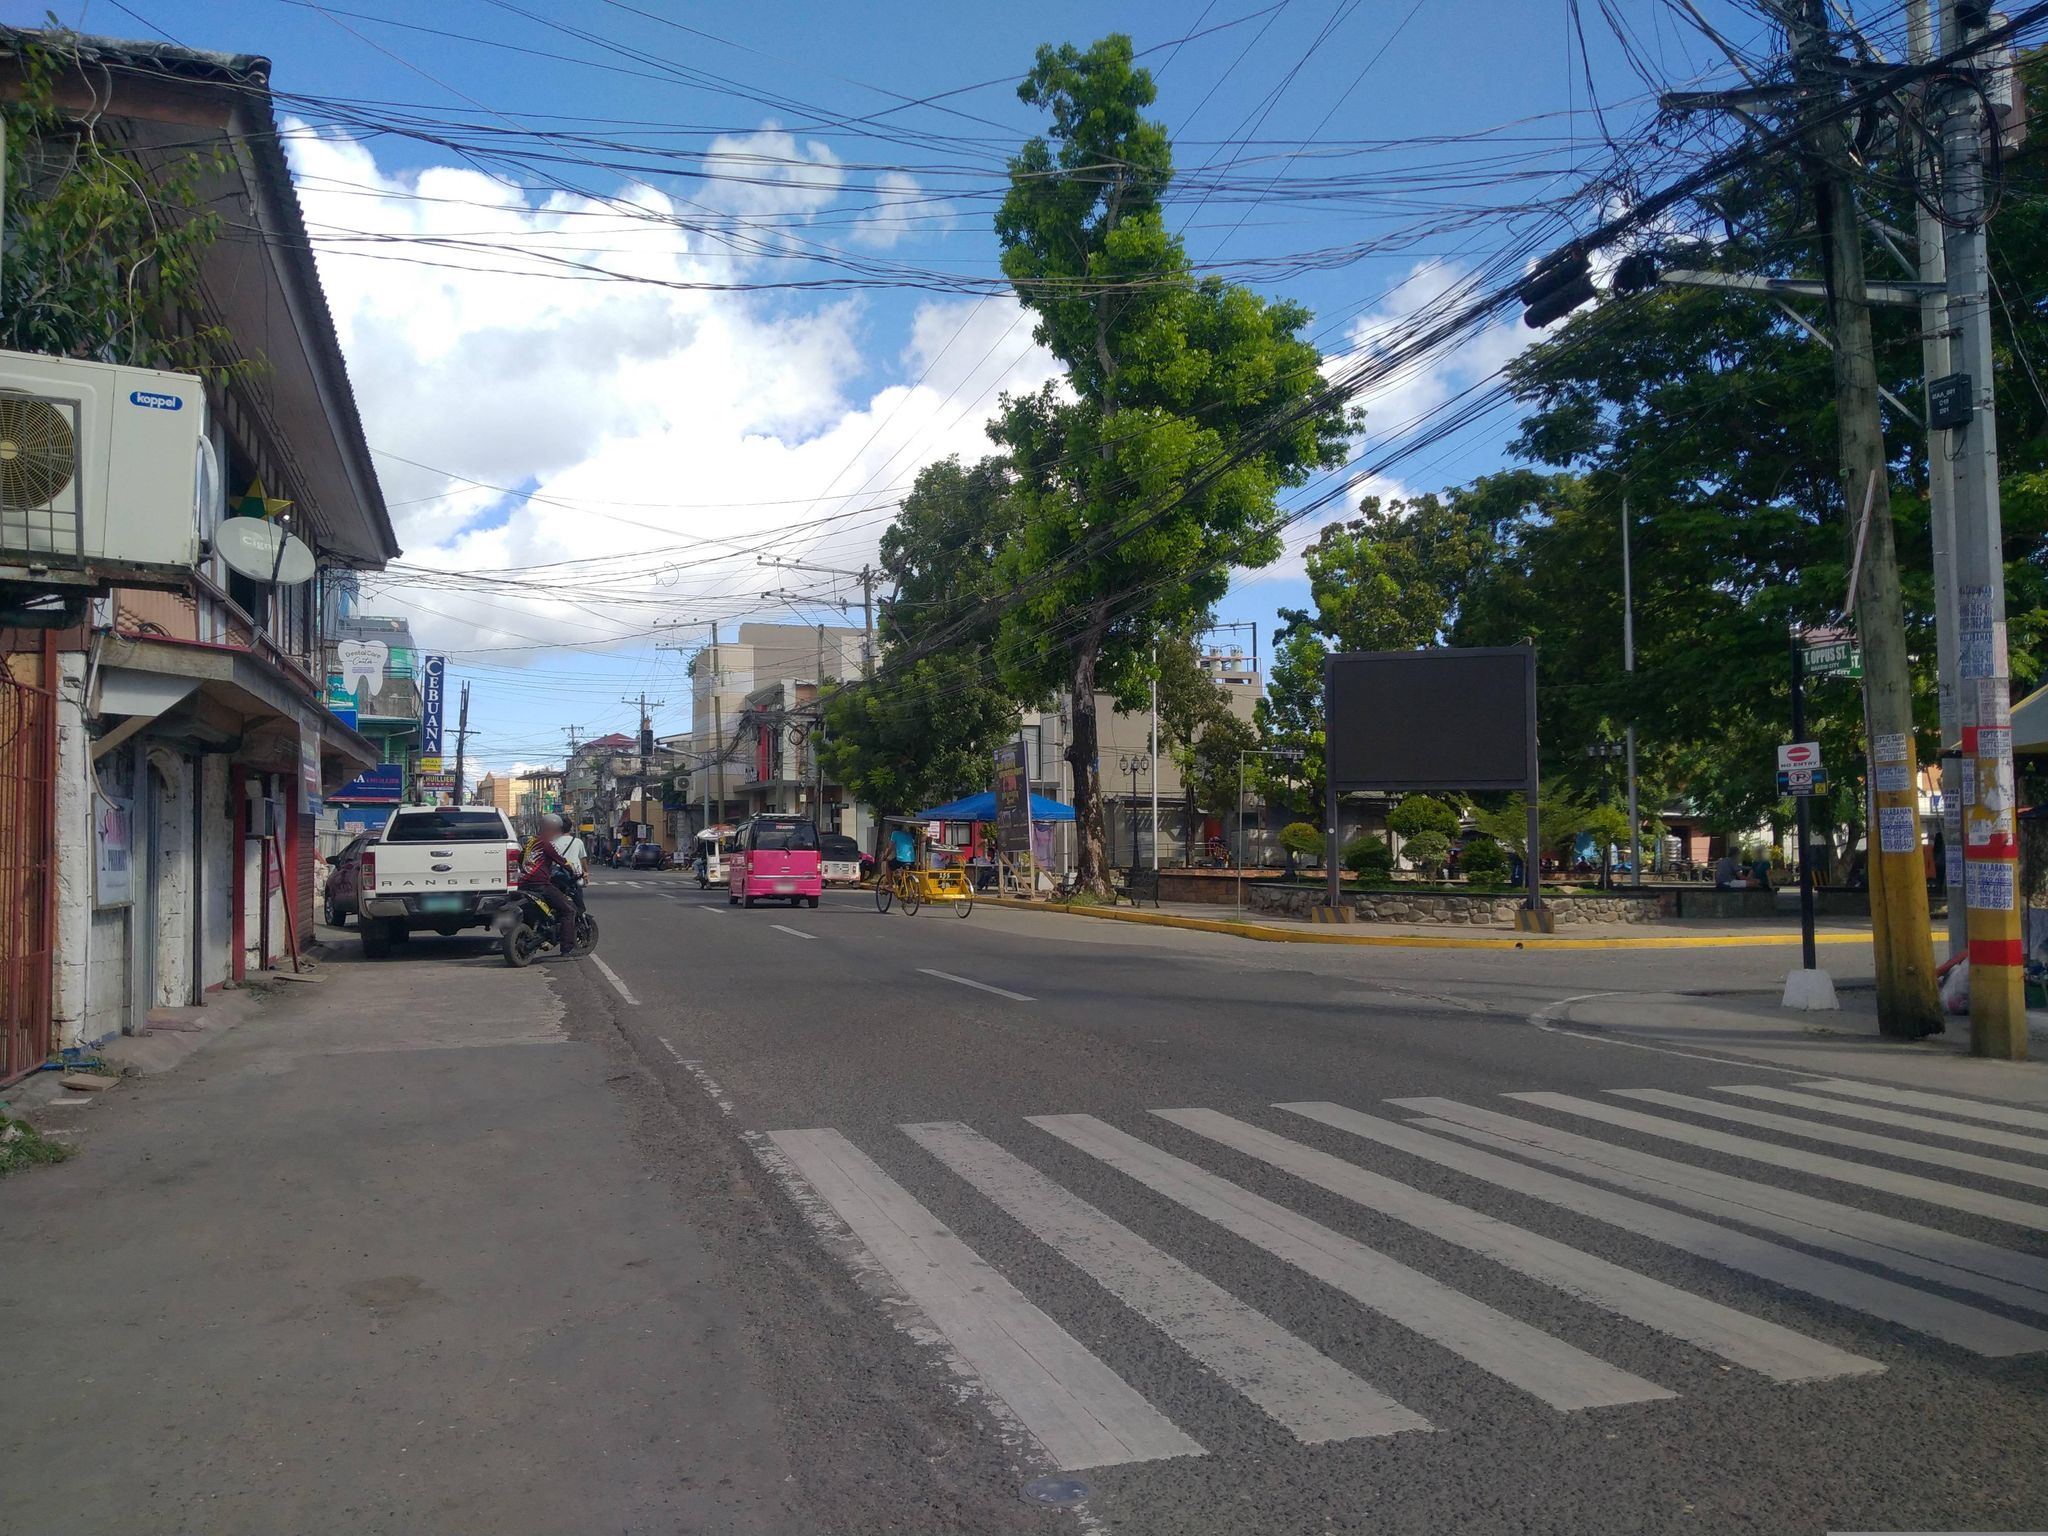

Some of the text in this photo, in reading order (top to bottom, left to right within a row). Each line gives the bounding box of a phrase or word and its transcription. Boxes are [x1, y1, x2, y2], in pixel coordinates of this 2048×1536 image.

[136, 392, 176, 408] koppel
[243, 536, 281, 552] Cigna
[1811, 648, 1836, 665] OPPUS
[1836, 645, 1848, 660] ST.
[426, 657, 442, 752] CEBUANA
[381, 878, 502, 887] RANGER
